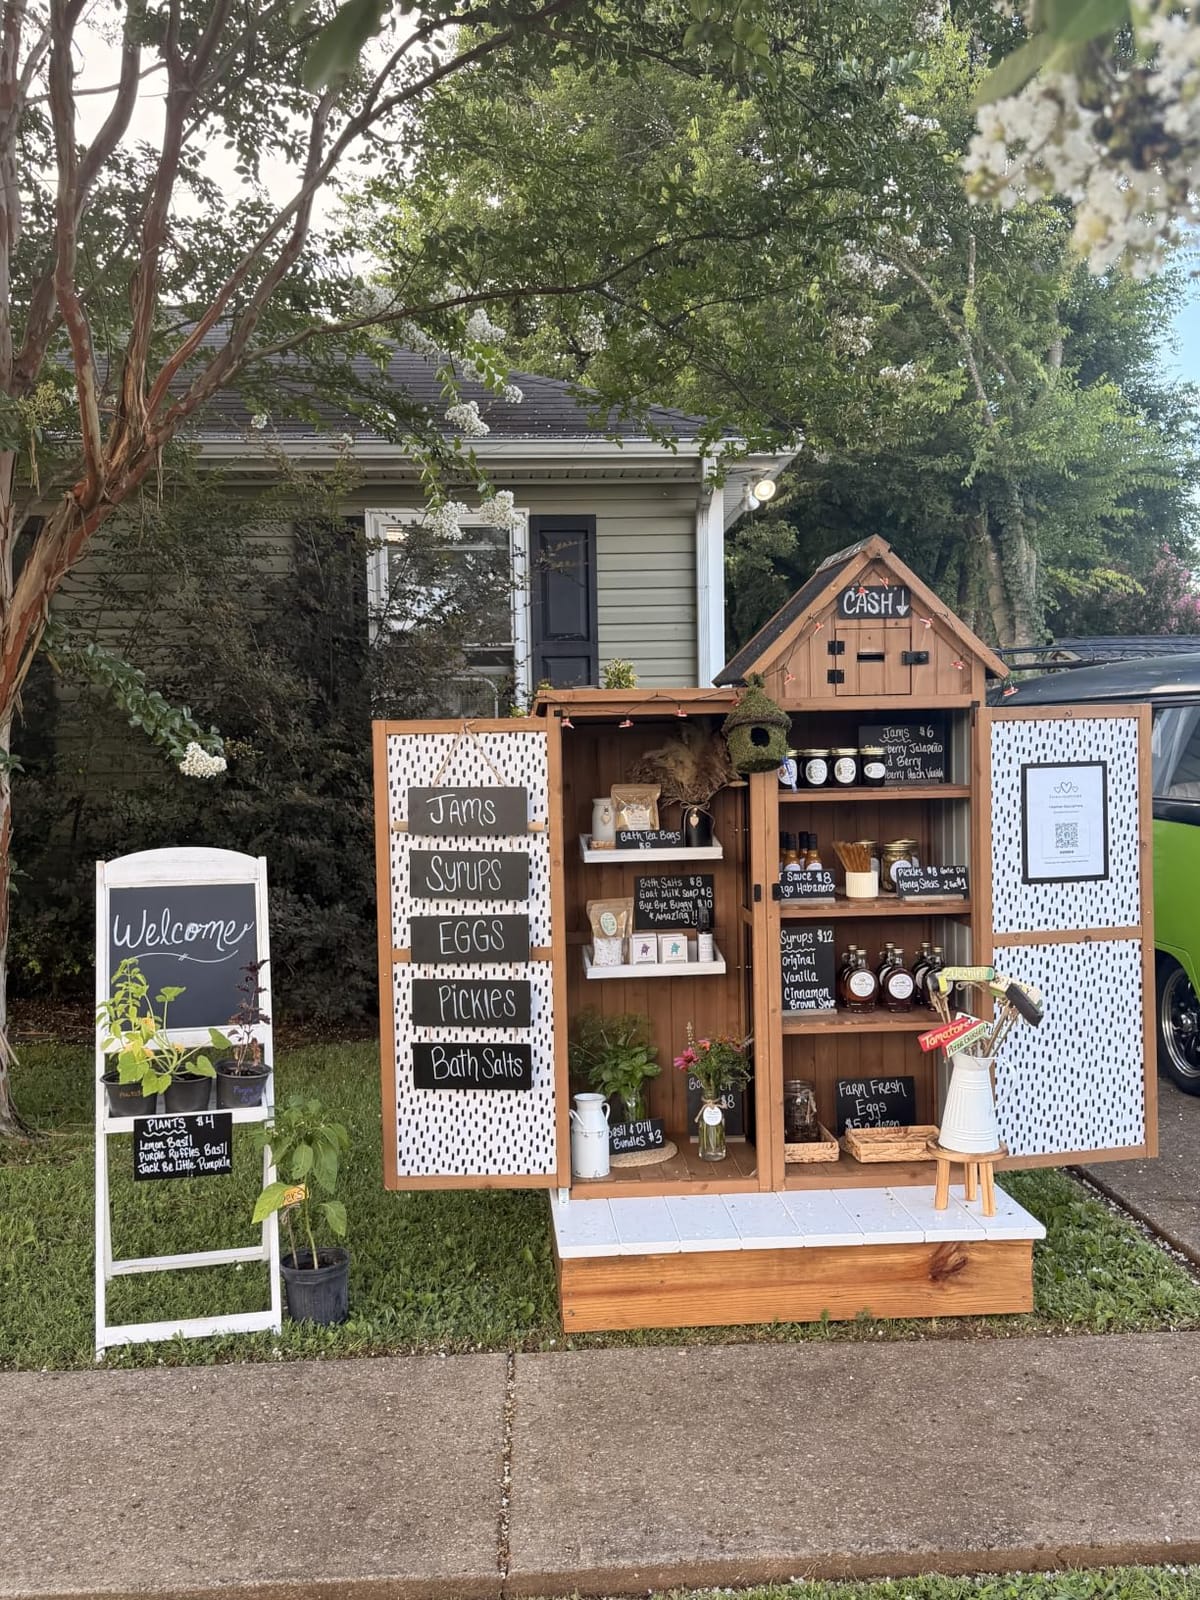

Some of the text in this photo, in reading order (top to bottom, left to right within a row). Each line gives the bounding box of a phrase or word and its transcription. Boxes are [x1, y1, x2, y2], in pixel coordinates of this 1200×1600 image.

[843, 590, 893, 615] CASH
[882, 725, 934, 740] Jams $6
[897, 756, 921, 770] Berry
[620, 830, 681, 844] Bath Tea Bags
[640, 877, 702, 888] Bath Salts $8
[787, 871, 812, 882] Sauce
[640, 888, 658, 899] Goat
[796, 883, 836, 895] Habanero
[899, 880, 920, 892] Honey
[943, 880, 950, 890] 2
[639, 900, 653, 912] Bye
[112, 907, 255, 951] Welcome
[439, 920, 505, 956] EGGS
[780, 929, 834, 950] Syrups $12
[783, 970, 819, 984] Vanilla
[784, 987, 831, 1001] Cinnamon
[789, 999, 816, 1011] Brown
[431, 1046, 523, 1082] Bath Salts
[856, 1099, 887, 1120] Eggs
[196, 1114, 214, 1129] $4
[635, 1119, 652, 1134] Dill
[845, 1118, 861, 1129] $5
[140, 1134, 193, 1151] Lemon Basil
[613, 1129, 663, 1150] Bundles $3
[169, 1147, 200, 1160] Ruffles
[204, 1141, 228, 1156] Basil
[138, 1156, 232, 1174] Jack Be Little Pumpkin
